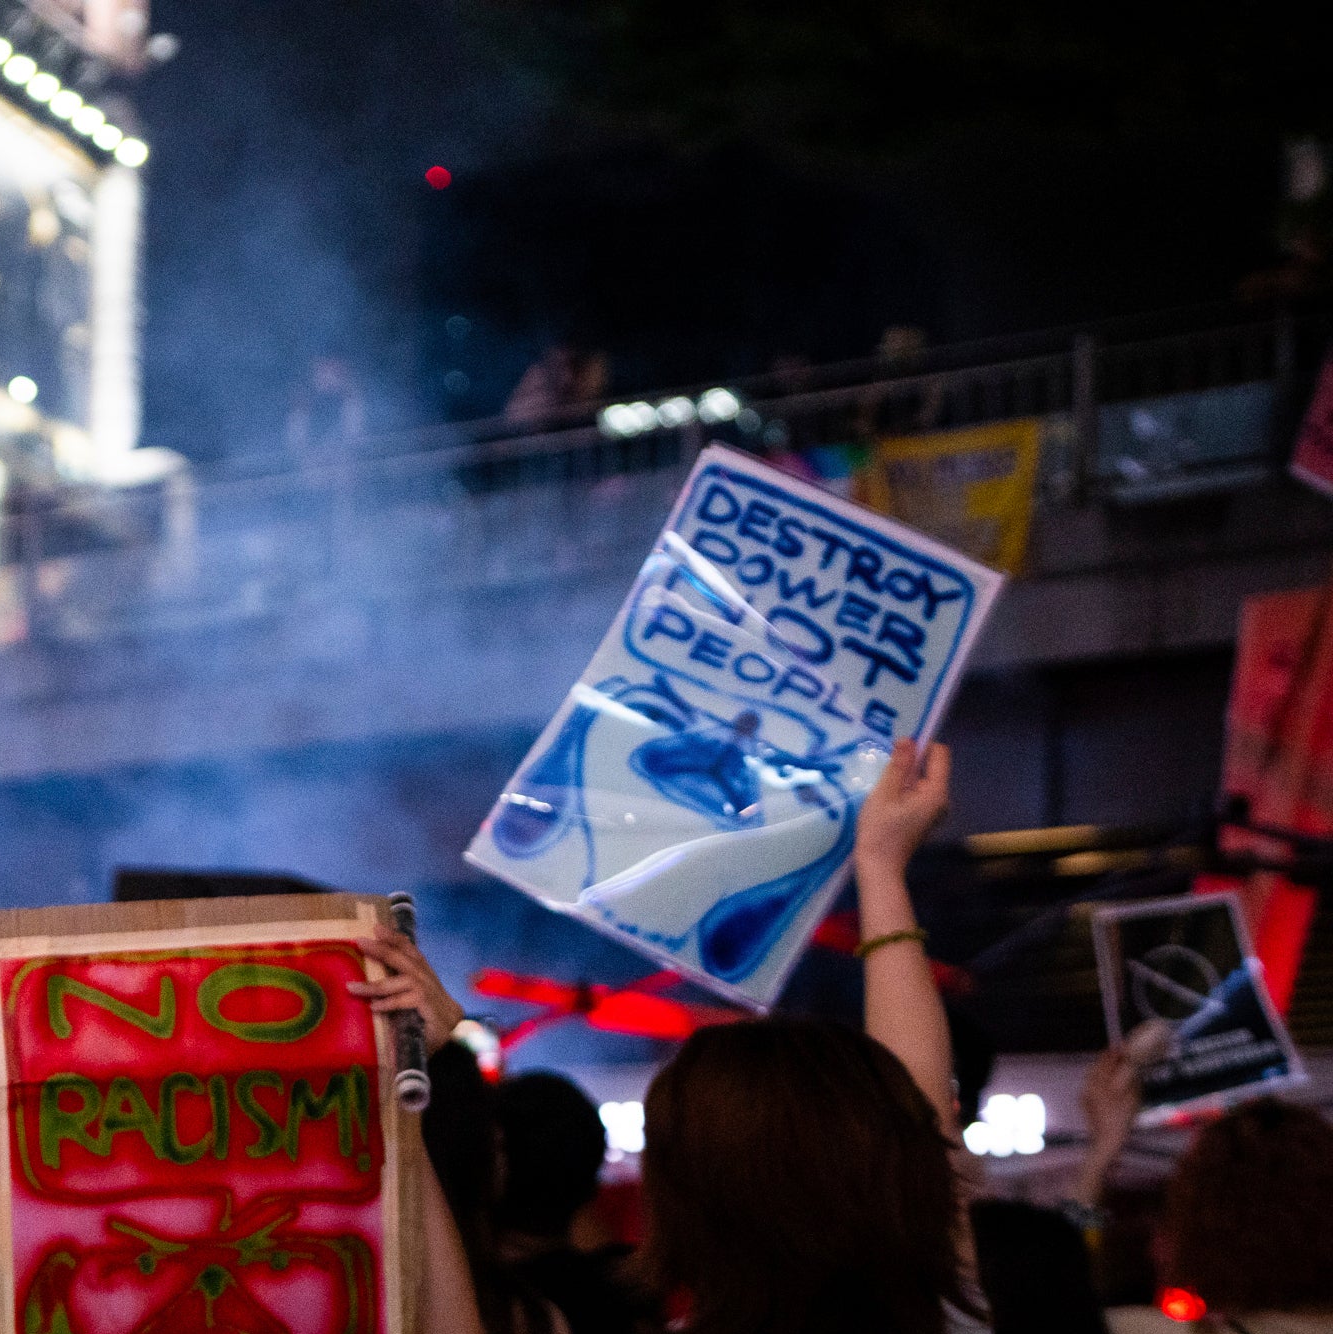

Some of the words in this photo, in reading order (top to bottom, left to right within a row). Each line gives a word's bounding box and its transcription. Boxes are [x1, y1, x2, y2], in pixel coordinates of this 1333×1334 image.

[698, 483, 962, 620] DESTROY
[643, 605, 898, 737] PEOPLE
[46, 963, 327, 1044] NO
[38, 1066, 372, 1172] RACISM!
